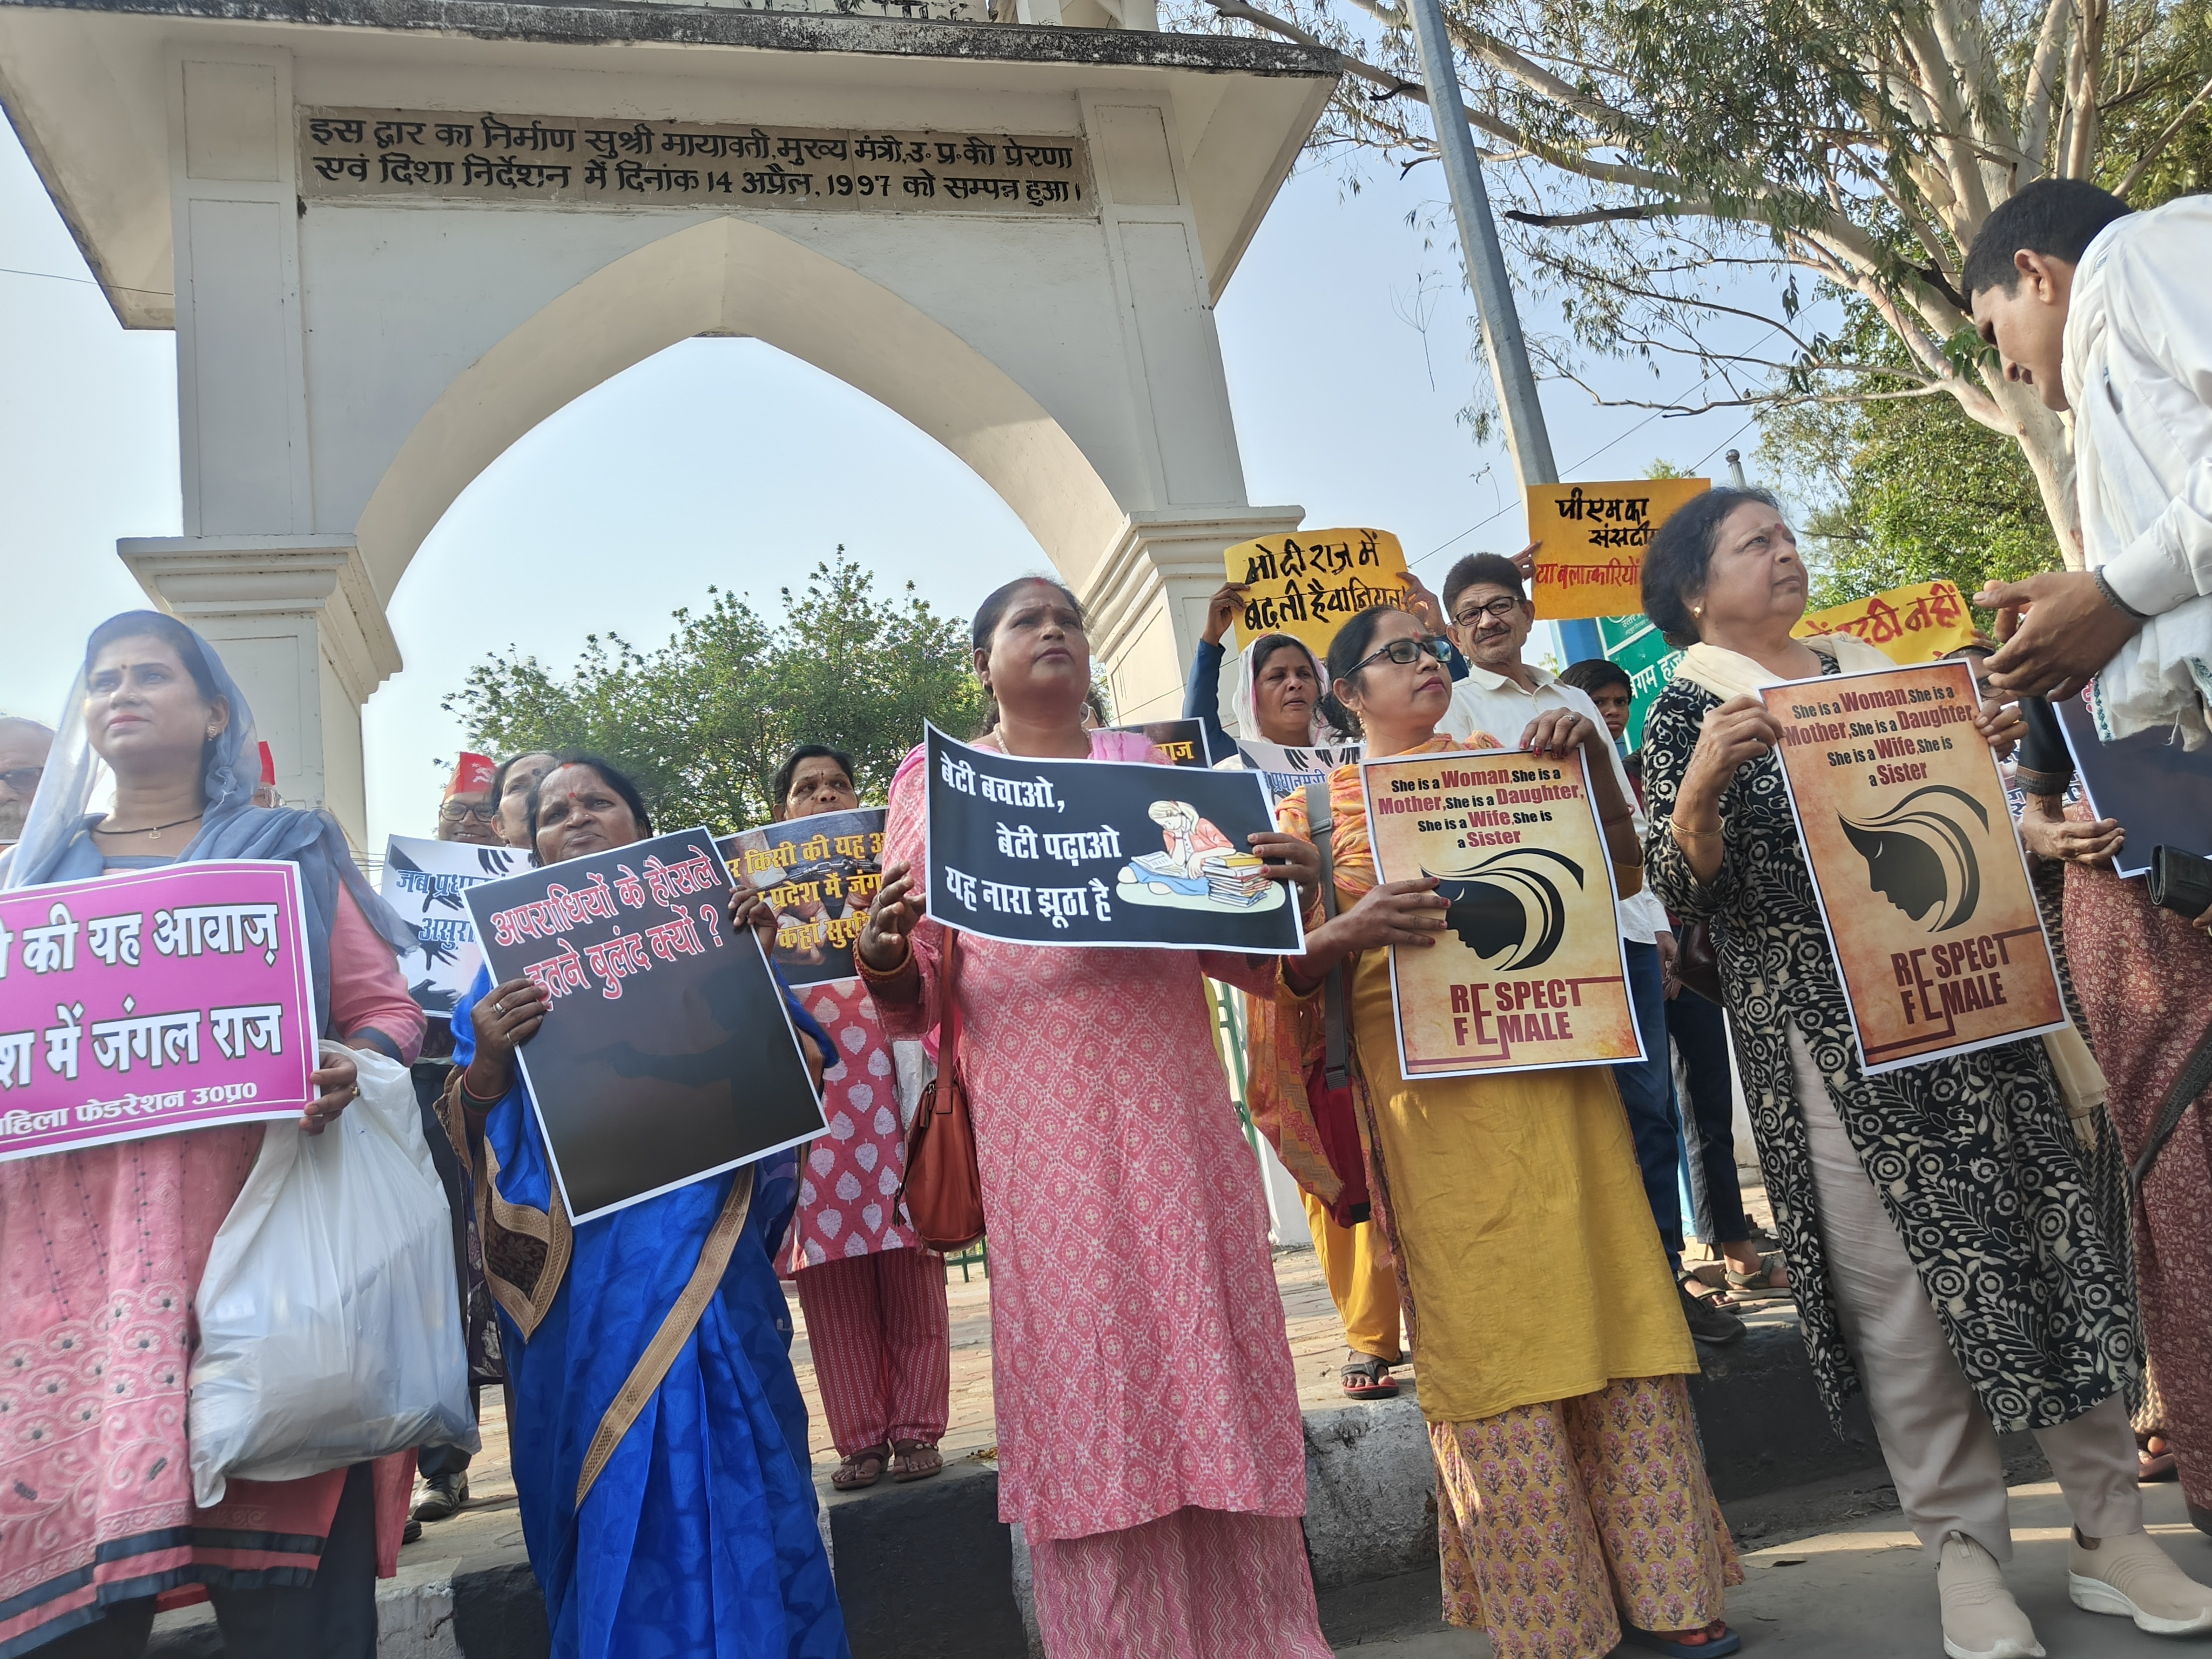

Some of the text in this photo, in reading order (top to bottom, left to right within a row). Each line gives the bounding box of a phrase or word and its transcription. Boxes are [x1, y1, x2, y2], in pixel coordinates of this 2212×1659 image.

[309, 118, 367, 145] इस
[374, 121, 426, 149] द्वार
[434, 124, 474, 147] का
[481, 116, 576, 151] निर्माण
[585, 123, 655, 159] सुश्री
[1002, 138, 1073, 168] प्रेरणा
[311, 153, 370, 182] एवं
[378, 152, 454, 185] दिशा
[462, 153, 571, 188] निर्देशन
[585, 158, 608, 190] में
[616, 160, 699, 192] दिनांक
[707, 171, 733, 193] 14
[827, 174, 892, 198] 1997
[903, 168, 937, 198] को
[1555, 487, 1649, 526] पीएम का
[1244, 538, 1306, 585] मोदी
[1358, 529, 1380, 567] में
[1535, 563, 1559, 584] या
[1905, 583, 1961, 631] नहीं
[1791, 705, 1817, 719] She
[1819, 703, 1831, 716] is
[1831, 702, 1841, 713] a
[1933, 686, 1945, 699] is
[1946, 686, 1954, 698] a
[1876, 720, 1888, 734] is
[1889, 719, 1898, 732] a
[1827, 752, 1852, 767] She
[1854, 749, 1866, 763] is
[1867, 748, 1876, 761] a
[1941, 736, 1953, 750] is
[940, 750, 977, 796] बेटी
[1392, 780, 1415, 792] She
[1418, 778, 1430, 790] is
[1432, 778, 1440, 789] a
[1538, 768, 1551, 781] is
[1552, 768, 1561, 779] a
[1869, 761, 1928, 787] a Sister
[1472, 795, 1484, 807] is
[1486, 795, 1494, 806] a
[1418, 820, 1442, 832] She
[1445, 818, 1457, 830] is
[1459, 818, 1467, 829] a
[1540, 810, 1553, 822] is
[1458, 830, 1521, 848] a Sister
[744, 842, 798, 874] किसी
[800, 834, 831, 866] की
[834, 832, 865, 860] यह
[996, 821, 1122, 866] बेटी पढ़ाओ
[396, 869, 432, 894] जब
[491, 844, 722, 946] अपराधियों के हौसले
[770, 880, 820, 911] प्रदेश
[823, 872, 843, 899] में
[945, 865, 1112, 929] यह नारा झूठा है
[22, 902, 79, 974] की
[87, 913, 143, 967] यह
[152, 902, 279, 967] आवाज़
[584, 926, 652, 1000] बुलंद
[646, 903, 705, 962] क्यों
[777, 917, 821, 950] कहां
[45, 1001, 85, 1081] में
[91, 995, 202, 1074] जंगल
[210, 1003, 283, 1059] राज
